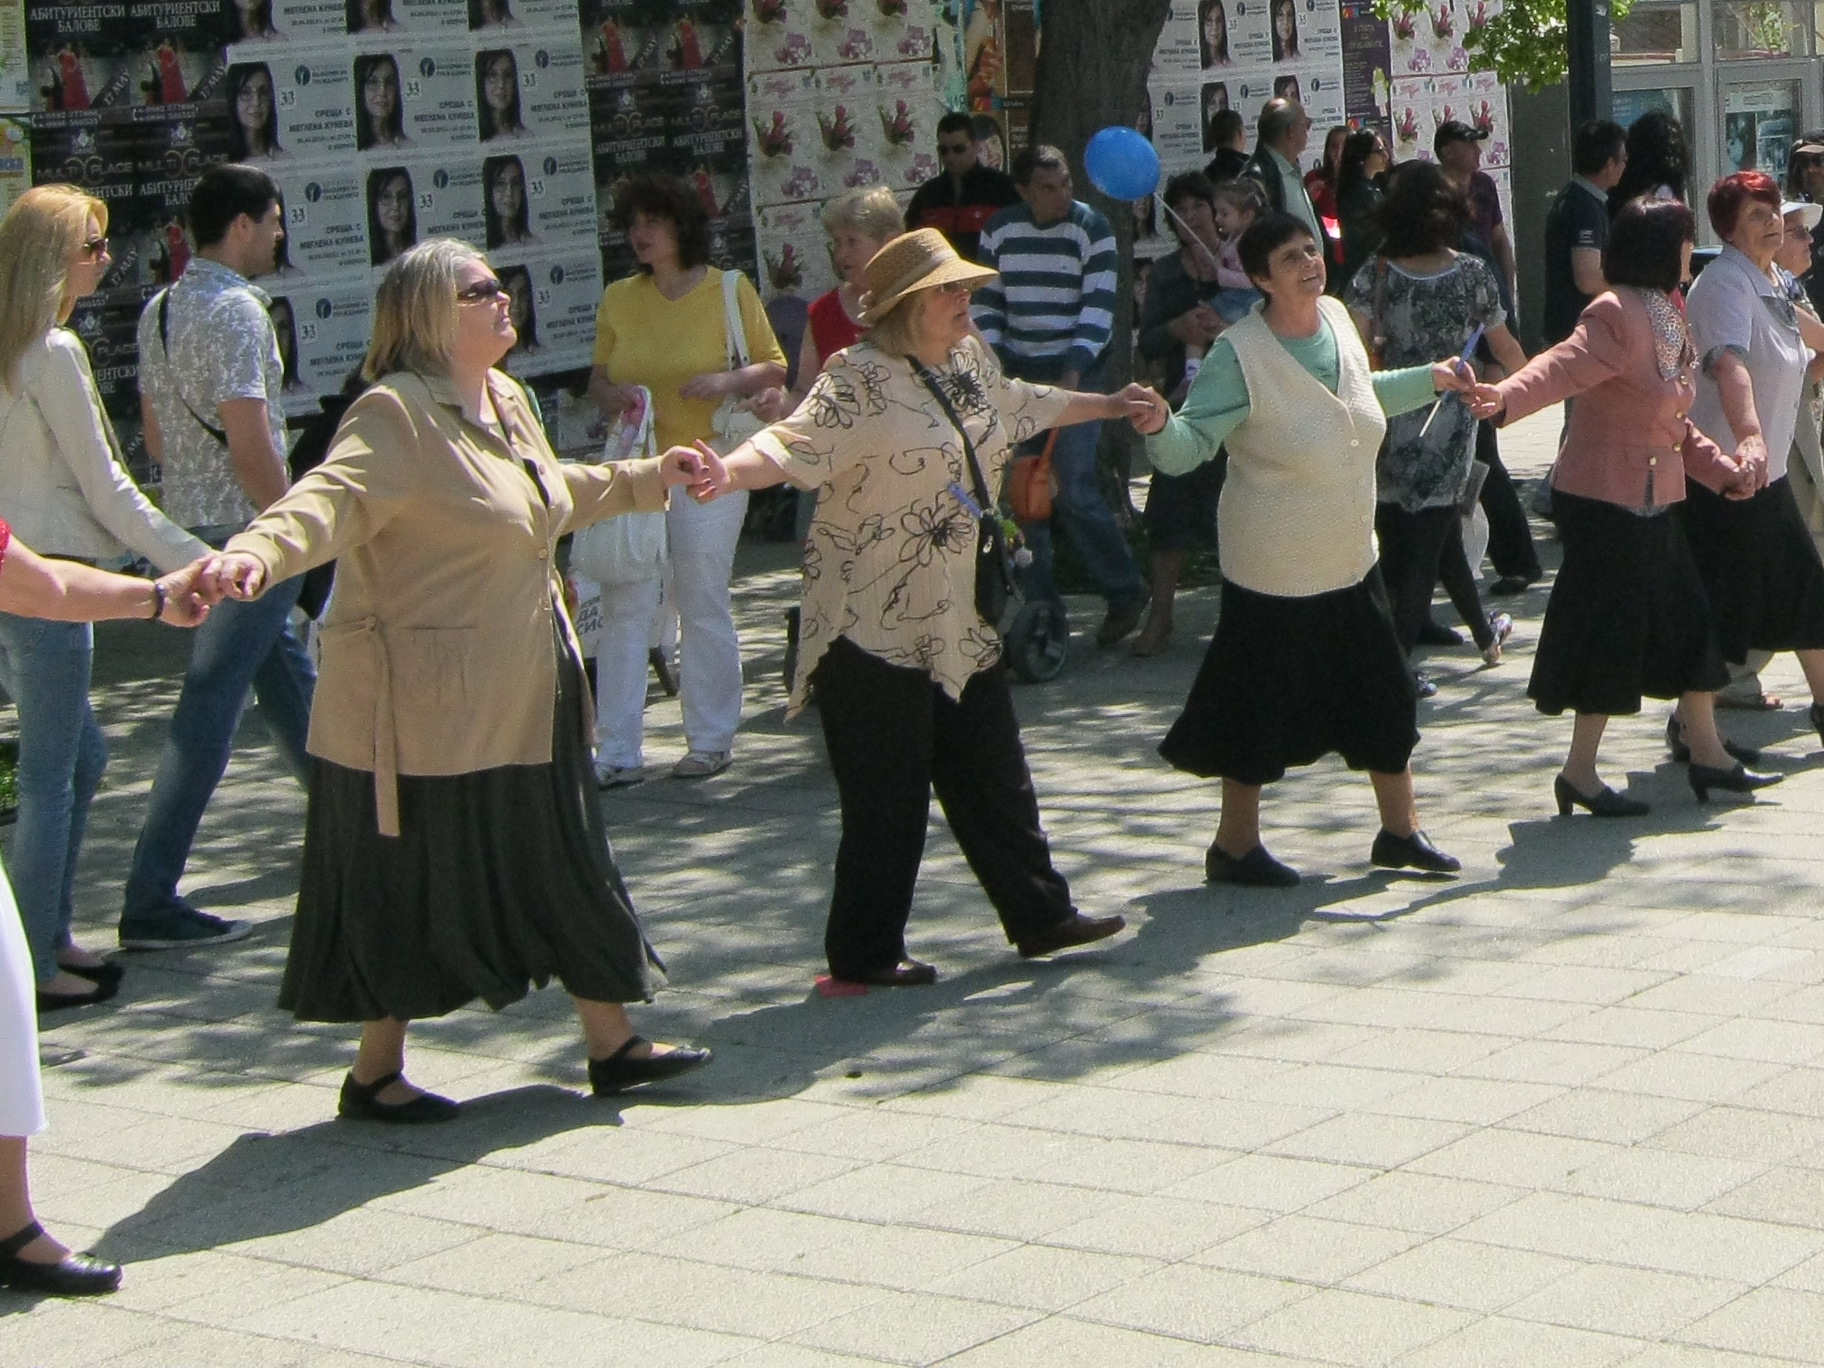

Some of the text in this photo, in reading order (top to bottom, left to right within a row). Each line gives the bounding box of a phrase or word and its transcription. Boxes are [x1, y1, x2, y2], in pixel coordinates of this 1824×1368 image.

[30, 4, 126, 21] АБИТУРИЕНТСКИ
[130, 1, 221, 17] АБИТУРИЕНТСКИ
[57, 18, 101, 33] БАЛОВЕ
[156, 14, 197, 29] БАЛОВЕ
[523, 73, 537, 87] 33
[406, 82, 420, 96] 33
[280, 90, 295, 106] 33
[139, 177, 203, 196] АБИТУРИЕ
[531, 180, 545, 195] 33
[418, 193, 434, 209] 33
[290, 208, 306, 224] 33
[537, 289, 551, 305] 33
[301, 324, 317, 340] 33
